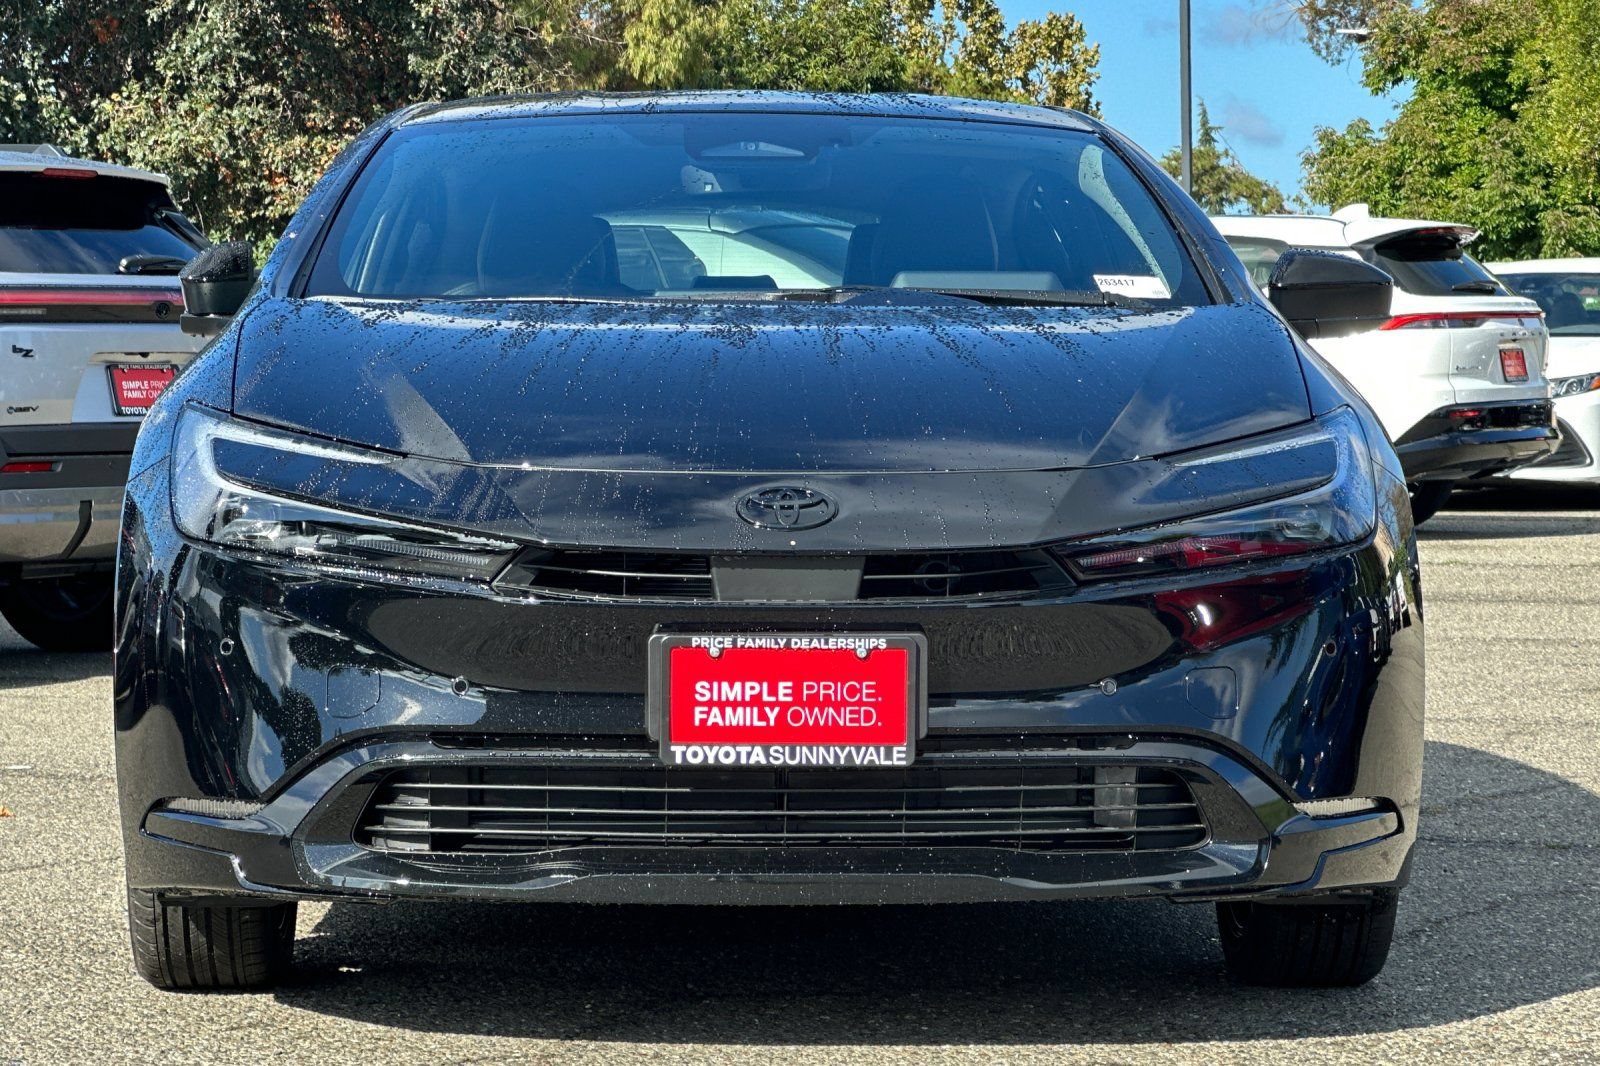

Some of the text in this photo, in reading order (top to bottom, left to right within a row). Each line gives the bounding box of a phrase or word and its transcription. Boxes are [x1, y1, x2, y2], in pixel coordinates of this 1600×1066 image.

[1098, 278, 1135, 287] 263417
[121, 380, 149, 390] SIMPLE
[123, 390, 147, 399] FAMILY
[121, 406, 148, 415] TOYOTA
[691, 637, 887, 649] PRICE FAMILY DEALERSHIPS
[694, 681, 882, 702] SIMPLE PRICE.
[694, 706, 882, 727] FAMILY OWNED.
[670, 745, 906, 765] TOYOTA SUNNYVALE
